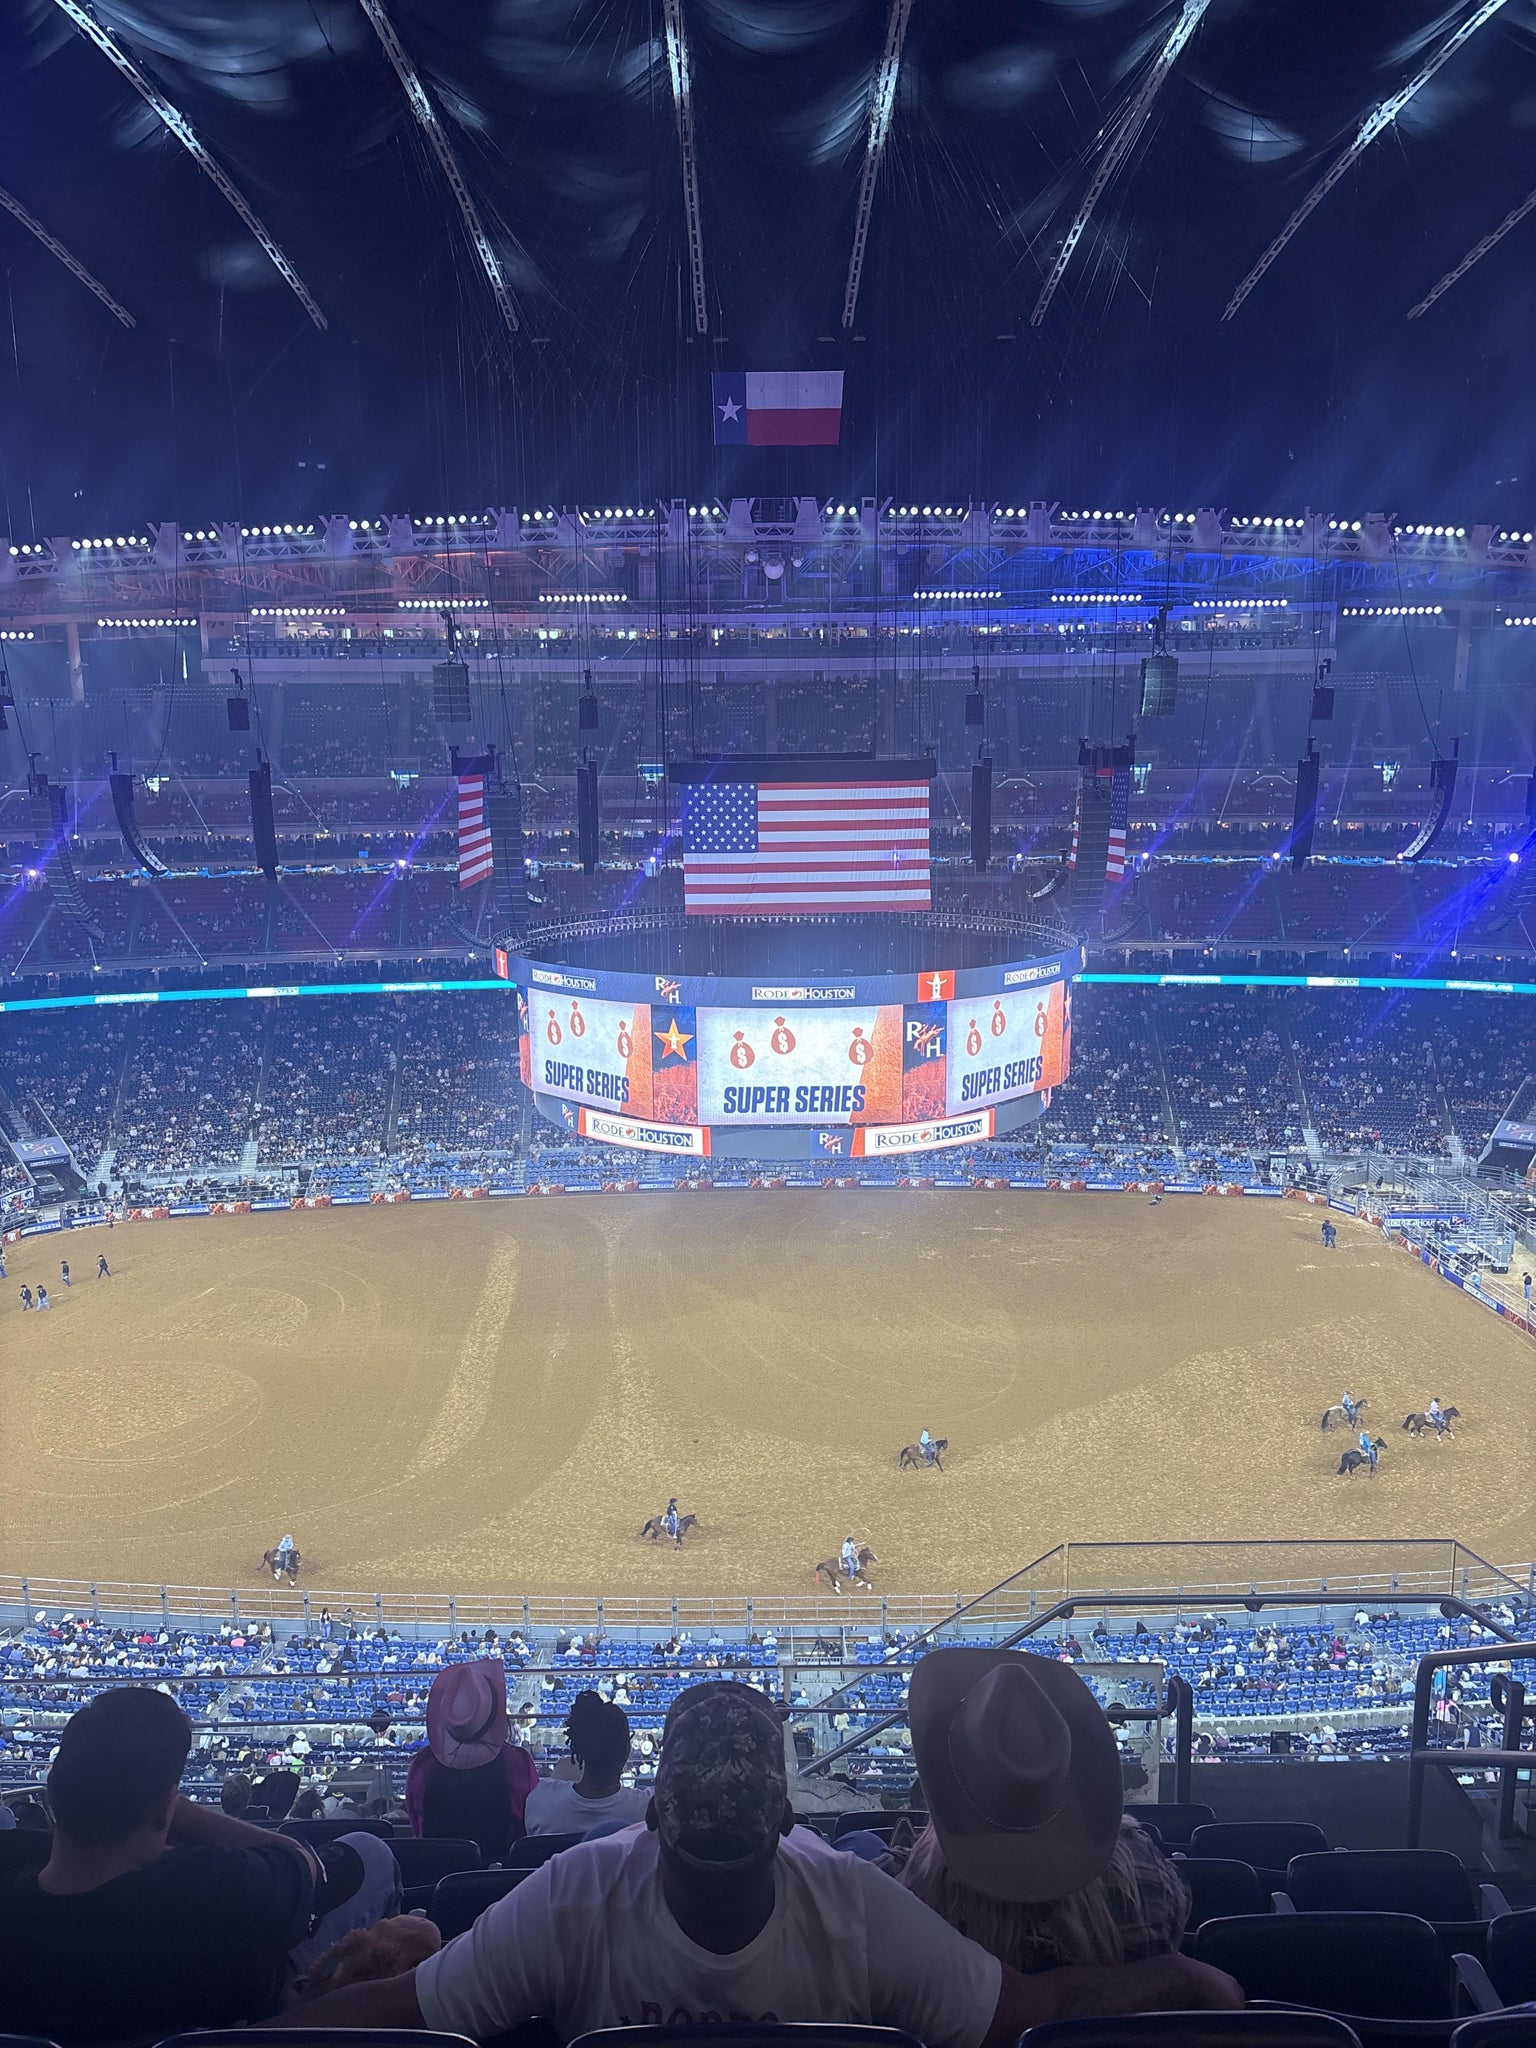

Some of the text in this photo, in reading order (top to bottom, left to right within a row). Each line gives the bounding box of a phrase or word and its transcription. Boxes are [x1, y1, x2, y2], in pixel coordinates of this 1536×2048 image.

[545, 1060, 629, 1103] SUPER SERIES
[724, 1085, 865, 1113] SUPER SERIES
[962, 1066, 1002, 1101] SUPER
[1003, 1055, 1042, 1090] SERIES
